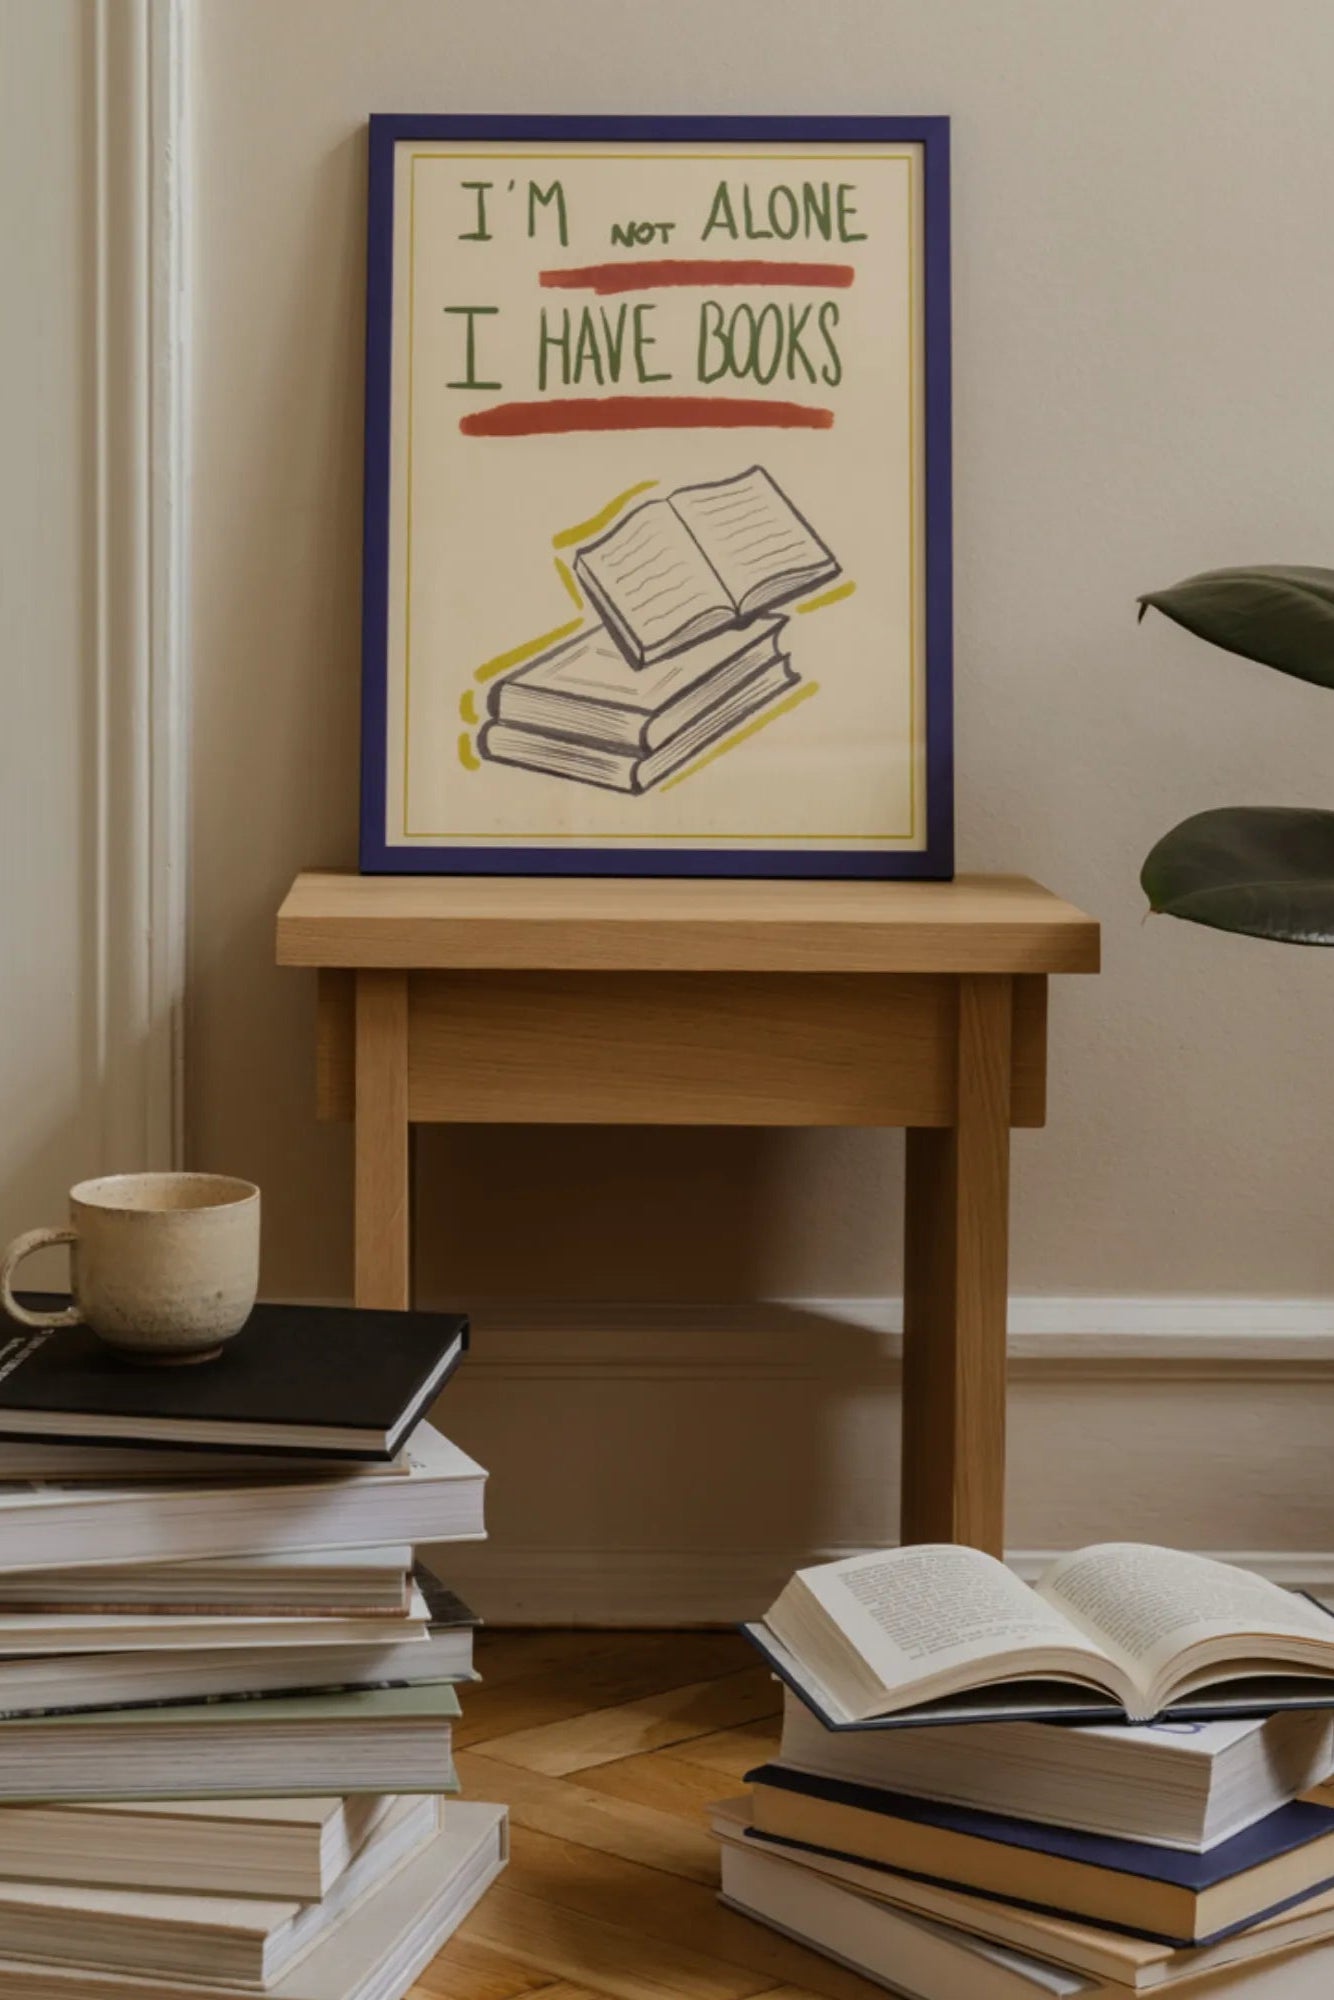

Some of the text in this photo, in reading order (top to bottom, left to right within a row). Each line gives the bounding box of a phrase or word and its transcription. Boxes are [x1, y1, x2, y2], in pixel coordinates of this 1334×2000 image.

[458, 180, 869, 247] I'M NOT ALONE
[443, 300, 843, 391] I HAVE BOOKS
